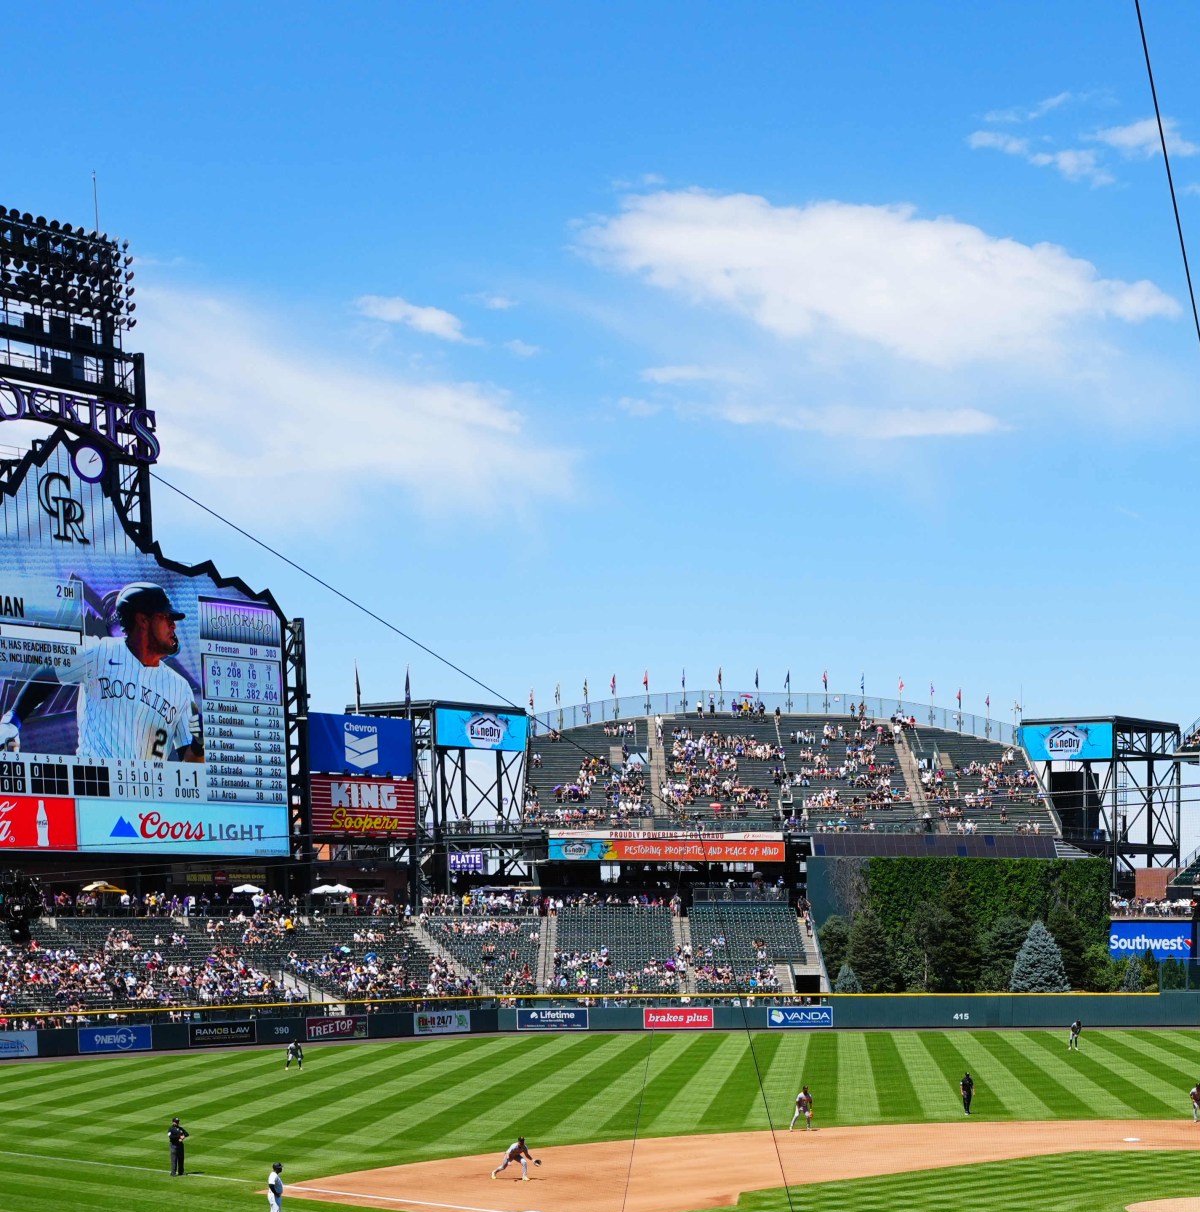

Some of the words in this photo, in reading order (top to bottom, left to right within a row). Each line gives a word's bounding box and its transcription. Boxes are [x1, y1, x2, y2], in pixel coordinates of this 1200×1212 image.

[56, 585, 62, 598] 2
[64, 586, 74, 598] DH
[211, 614, 272, 636] COLORADO
[9, 640, 22, 651] HAS
[23, 642, 52, 653] REACHED
[52, 644, 69, 655] BASE
[70, 646, 77, 656] IN
[215, 643, 240, 655] Freeman
[250, 647, 258, 657] DH
[10, 653, 43, 665] INCLUDING
[53, 657, 61, 667] OF
[98, 677, 178, 725] ROCKIES
[344, 722, 377, 734] Chevron
[151, 728, 168, 758] 2
[181, 787, 200, 799] OUTS
[330, 782, 398, 810] KING
[138, 811, 205, 840] Coors
[208, 823, 265, 841] LIGHT
[331, 807, 399, 832] Soopers
[609, 831, 640, 839] PROUDLY
[642, 831, 678, 839] POWERING
[624, 845, 662, 856] RESTORING
[664, 845, 706, 856] PROPERTIES
[708, 846, 723, 856] AND
[725, 846, 748, 856] PEACE
[749, 846, 759, 855] OF
[761, 846, 779, 856] MIND
[450, 854, 481, 864] PLATTE
[1110, 934, 1183, 951] Southwest
[437, 1015, 453, 1026] 24/7
[540, 1010, 575, 1019] Lifetime
[648, 1013, 684, 1023] brakes
[784, 1012, 830, 1021] VANDA
[195, 1027, 229, 1036] RAMOS
[230, 1026, 250, 1035] LAW
[274, 1026, 289, 1035] 390
[309, 1023, 334, 1038] TREE
[335, 1019, 353, 1033] TOP
